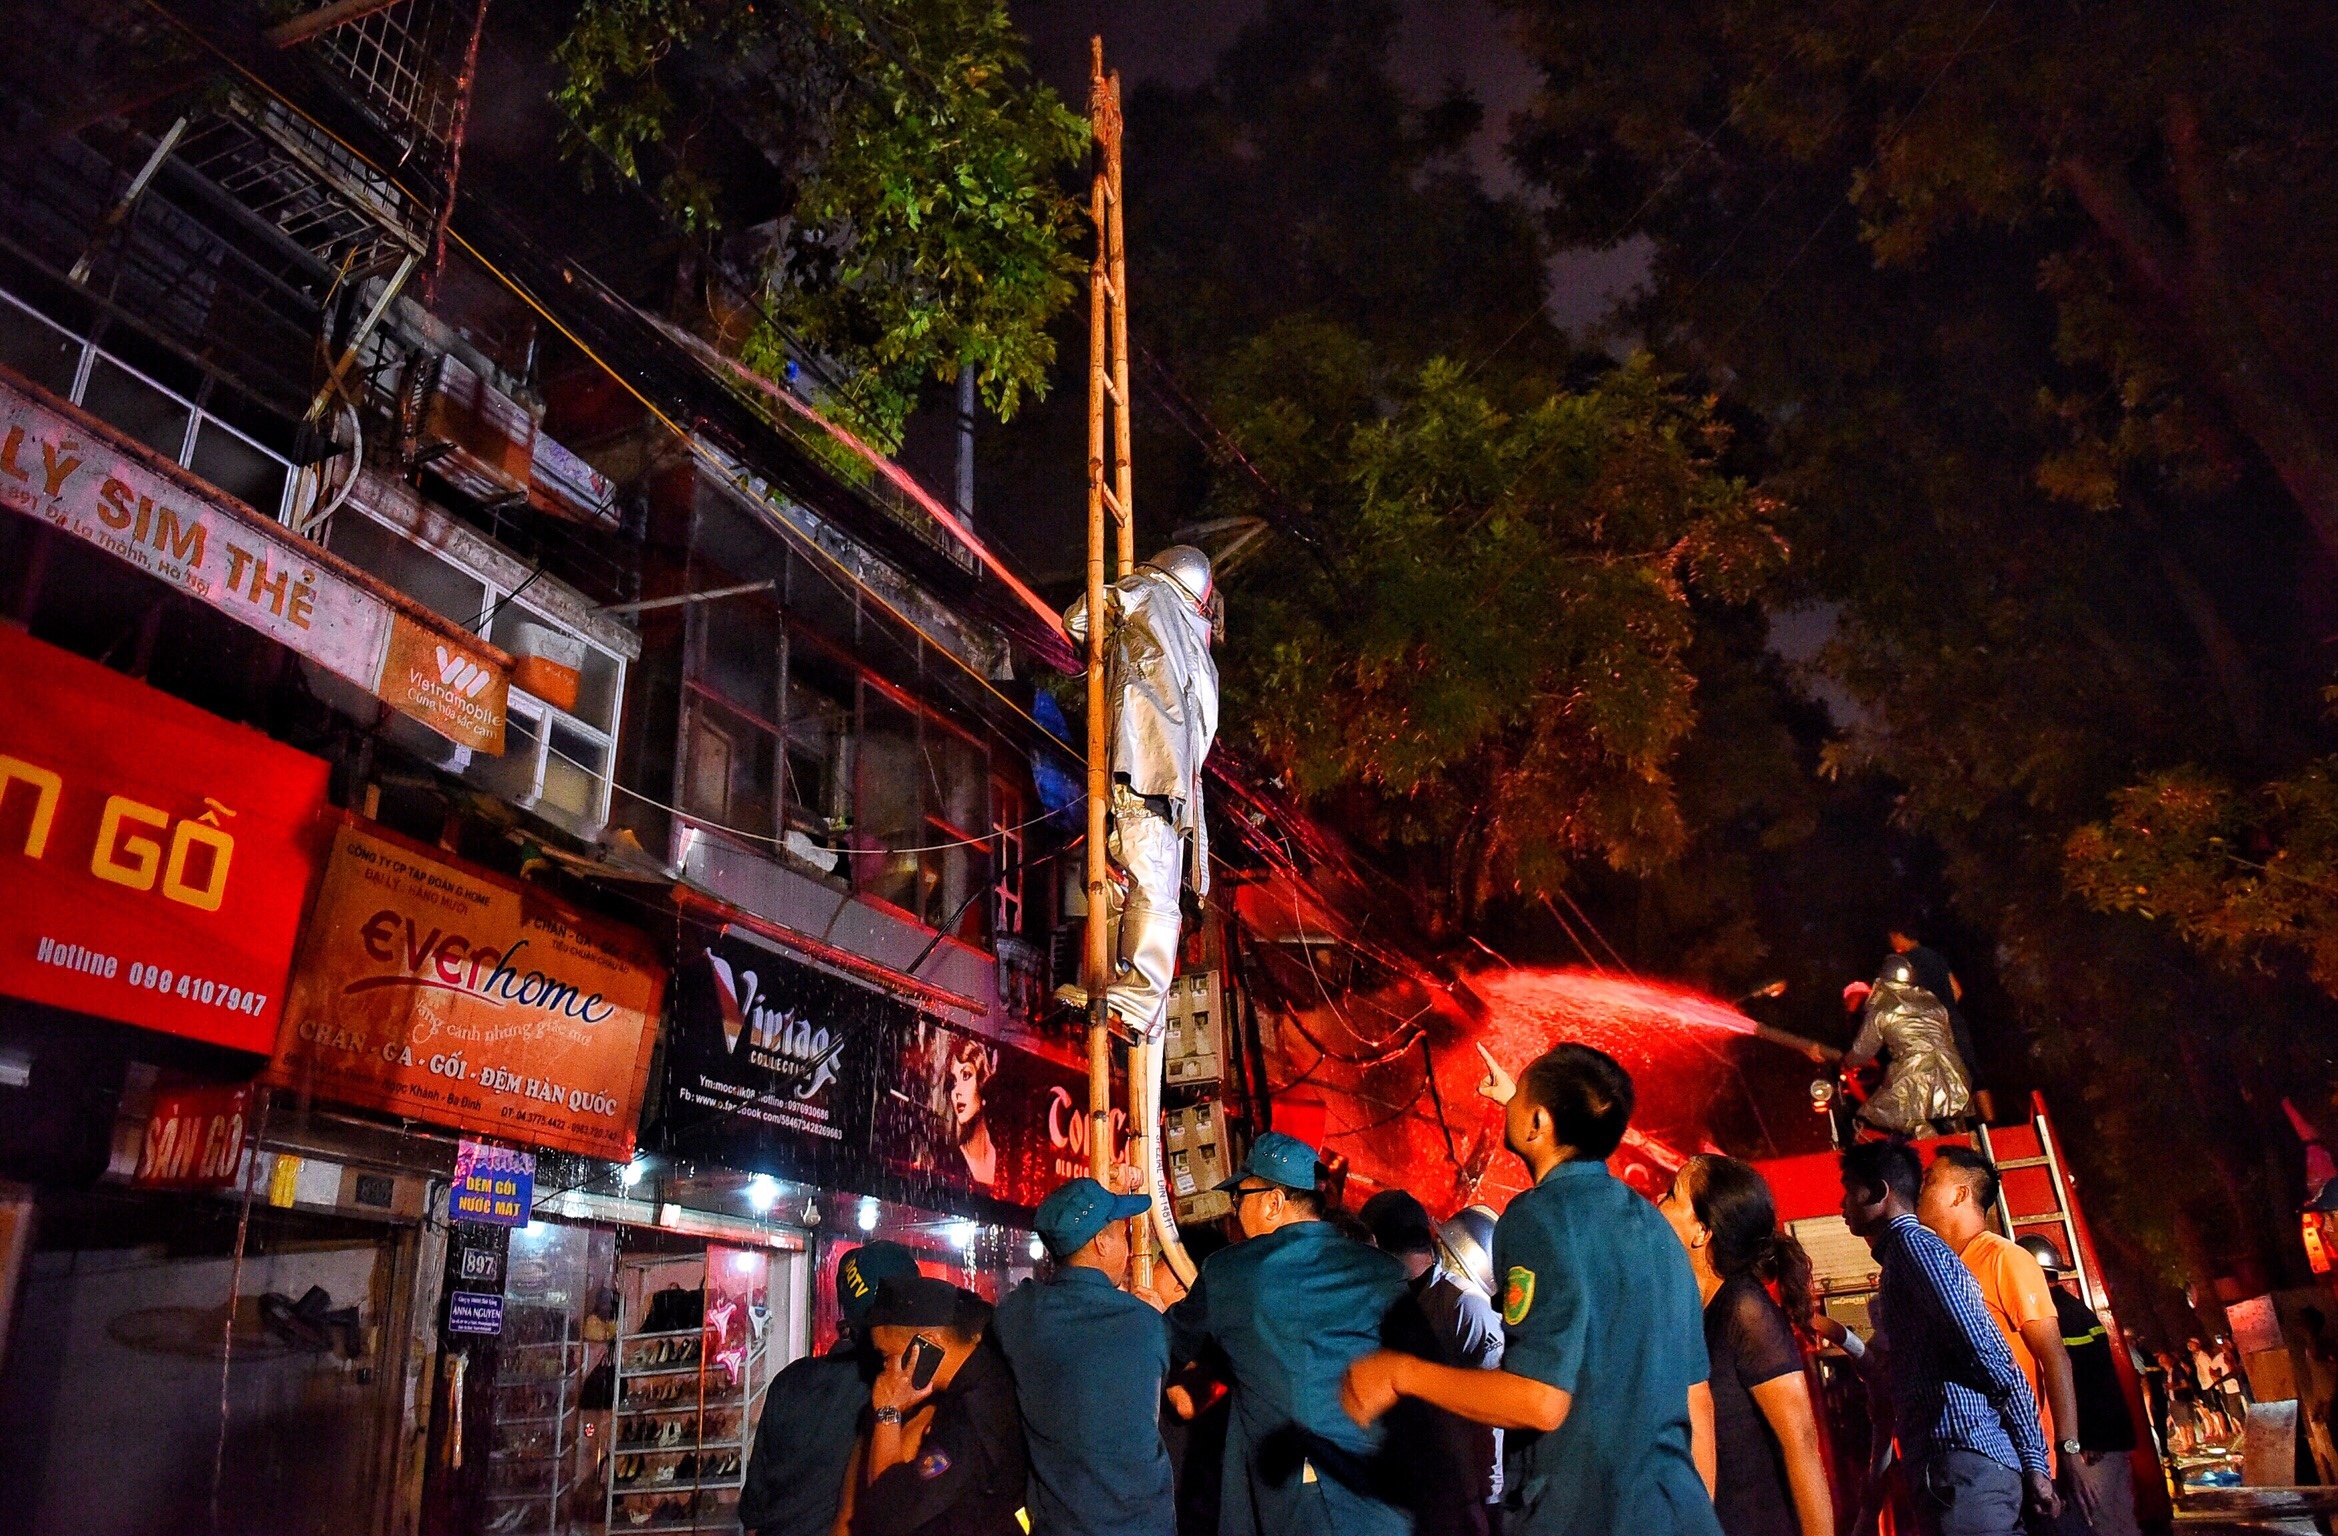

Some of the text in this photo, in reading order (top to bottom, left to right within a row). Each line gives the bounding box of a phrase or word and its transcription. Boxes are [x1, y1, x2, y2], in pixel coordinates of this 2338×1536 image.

[0, 425, 318, 631] LÝ SIM THẺ
[410, 667, 503, 728] Vietnamobile
[91, 796, 237, 912] GỖ
[378, 855, 392, 868] TY
[37, 936, 118, 979] Hotline
[382, 1041, 413, 1067] GA
[429, 1050, 469, 1080] GỐI
[479, 1065, 520, 1095] ĐỆM
[524, 1076, 567, 1105] HÀN
[568, 1088, 618, 1116] QUỐC
[140, 1089, 245, 1179] SÀN GỖ
[1157, 1180, 1168, 1199] DIN
[466, 1254, 496, 1275] 897
[452, 1306, 472, 1318] ANNA
